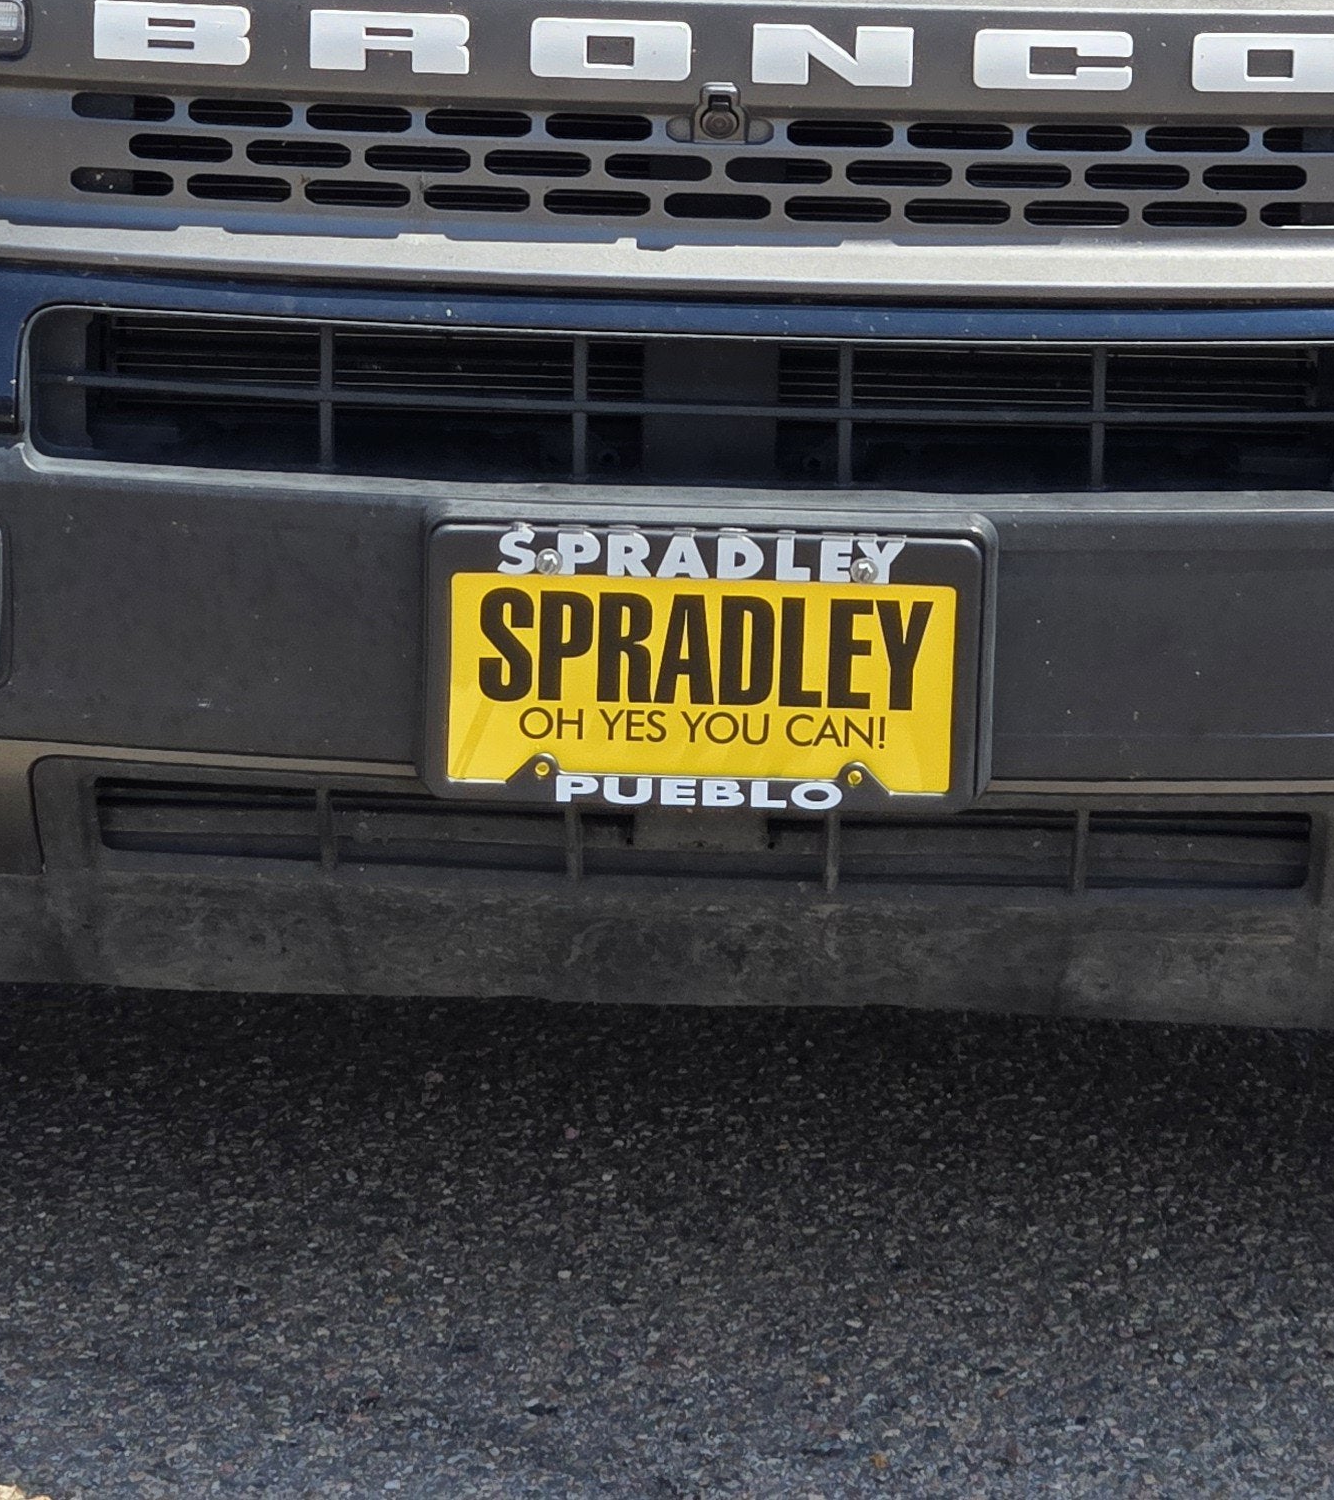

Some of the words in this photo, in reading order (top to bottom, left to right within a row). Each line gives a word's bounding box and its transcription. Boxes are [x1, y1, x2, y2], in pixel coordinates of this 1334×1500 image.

[498, 524, 907, 584] SPRADLEY
[478, 587, 934, 711] SPRADLEY
[519, 706, 584, 741] OH
[599, 709, 667, 743] YES
[686, 711, 771, 746] YOU
[785, 714, 885, 750] CAN!
[554, 774, 843, 811] PUEBLO
